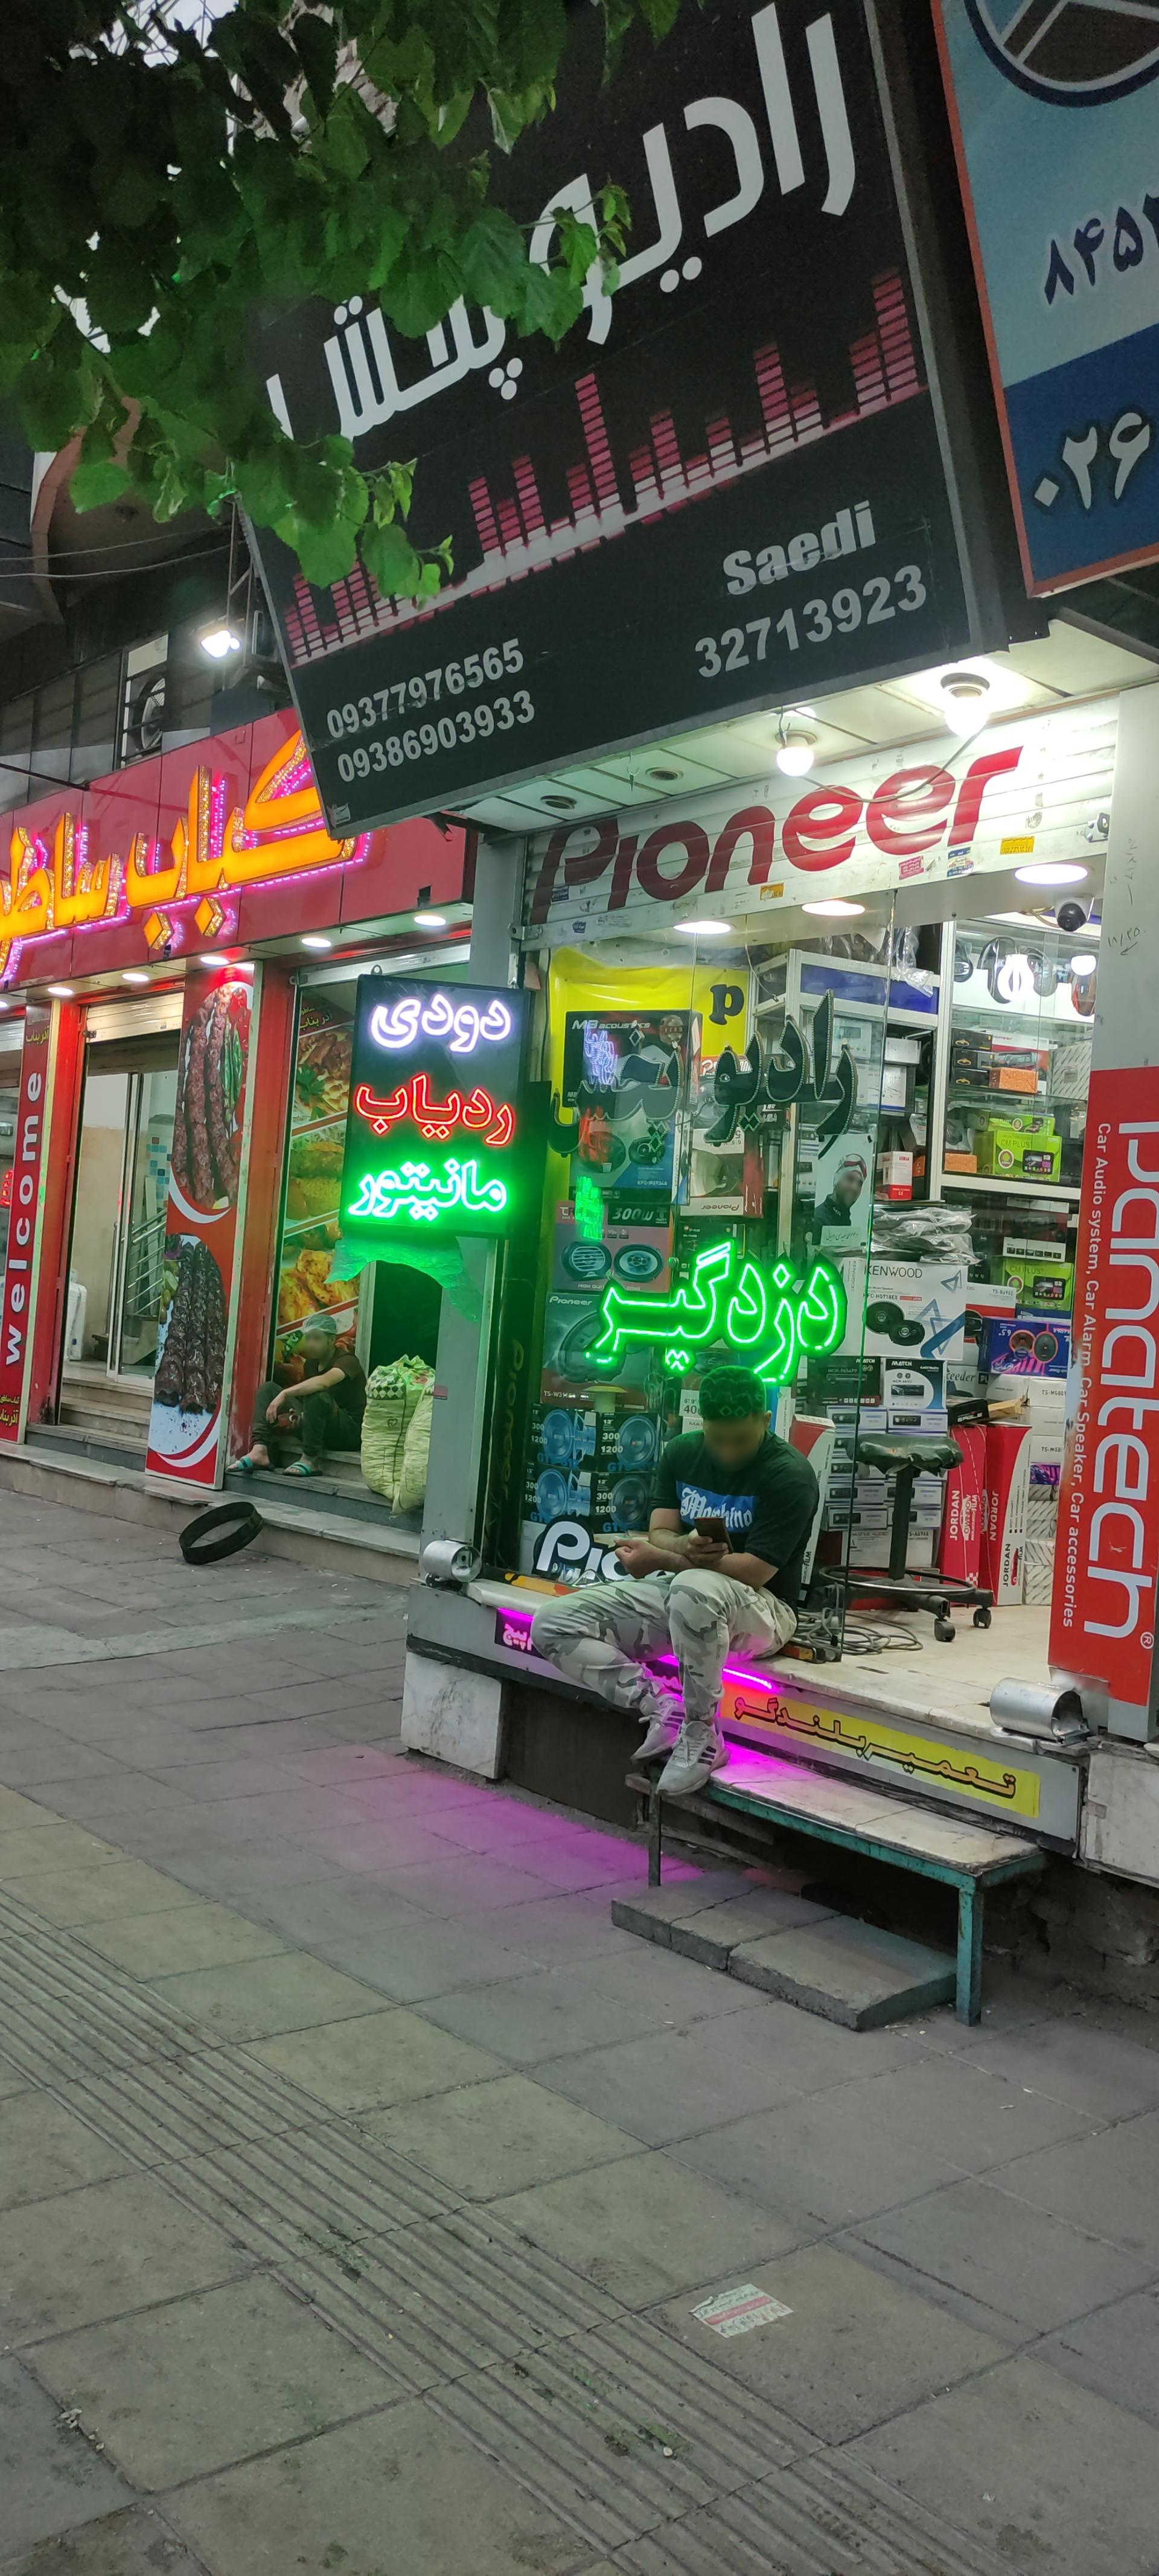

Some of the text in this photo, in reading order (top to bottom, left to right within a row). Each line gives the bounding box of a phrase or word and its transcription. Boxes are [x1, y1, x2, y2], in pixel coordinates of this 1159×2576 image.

[723, 500, 876, 595] Saedi
[695, 565, 927, 677] 32713923
[327, 639, 525, 738] 09377976565
[337, 690, 535, 782] 09386903933
[126, 730, 356, 951] کباب
[529, 745, 1023, 924] Pioneer
[371, 993, 511, 1052] دودی
[703, 989, 856, 1143] رادیو
[356, 1074, 513, 1145] ردیاب
[1097, 1123, 1111, 1153] Car
[347, 1158, 508, 1222] مانیتور
[1093, 1157, 1109, 1205] Audio
[5, 1072, 42, 1366] welcome
[1085, 1210, 1102, 1275] system,
[549, 1296, 592, 1306] Pioneer
[864, 1264, 923, 1278] KENWOOD
[1085, 1280, 1099, 1310] Car
[584, 1242, 838, 1382] دزدگیر
[531, 1435, 548, 1444] 1200
[532, 1423, 544, 1431] 300
[1070, 1412, 1089, 1487] Speaker,
[525, 1494, 541, 1503] 1200
[526, 1481, 538, 1490] 300
[950, 1490, 960, 1541] JORDAN
[989, 1490, 999, 1541] JORDAN
[1068, 1492, 1084, 1525] Car
[1003, 1543, 1011, 1587] JORDAN
[1062, 1528, 1079, 1628] accessories
[734, 1697, 1017, 1799] تعمیر بلندگو
